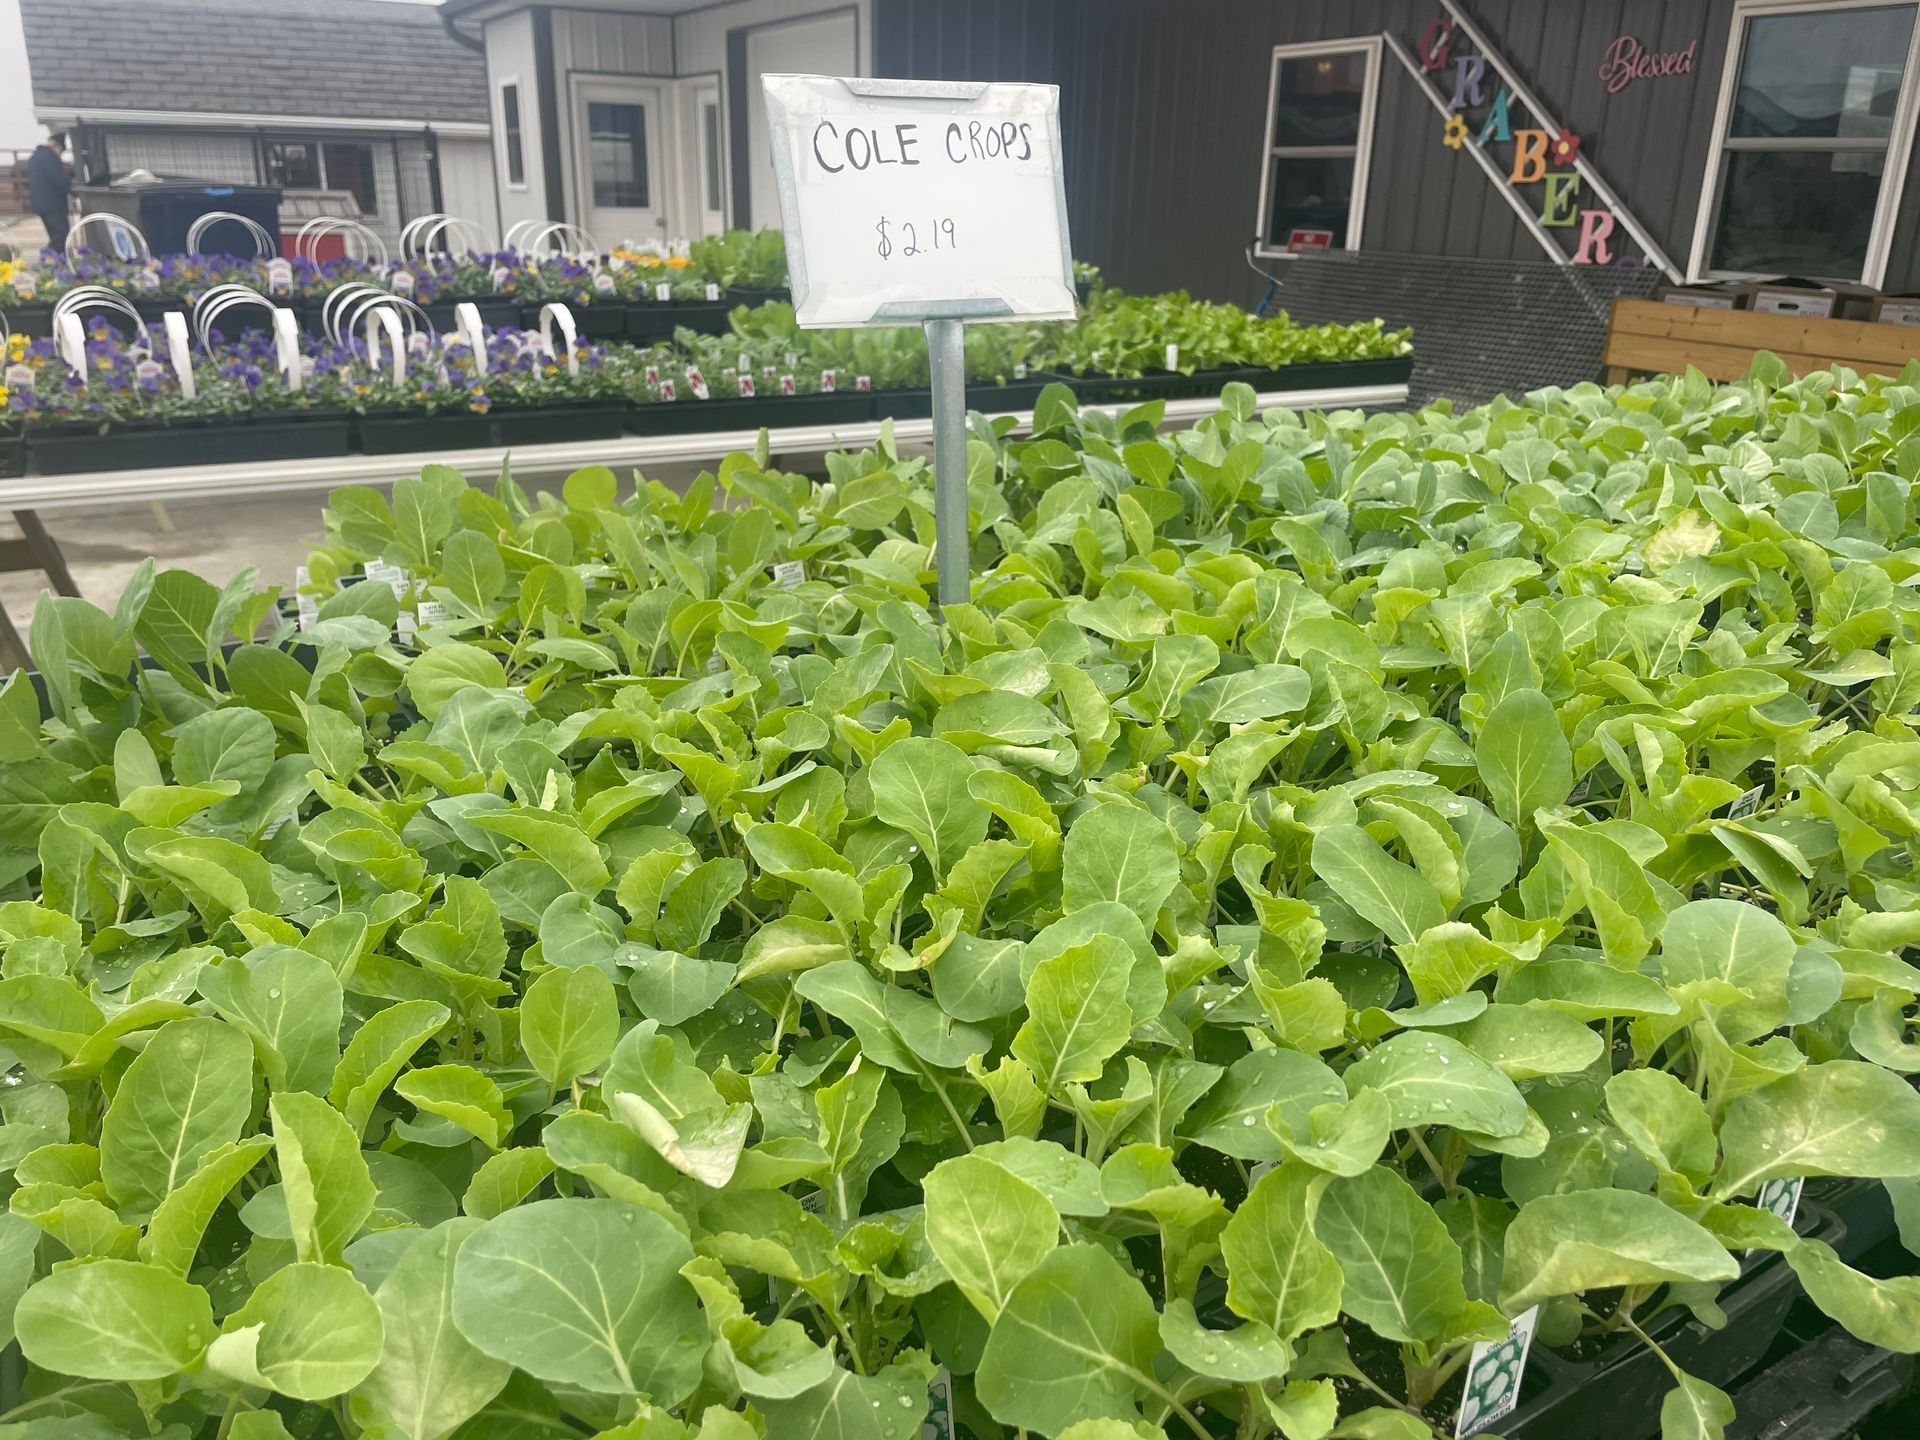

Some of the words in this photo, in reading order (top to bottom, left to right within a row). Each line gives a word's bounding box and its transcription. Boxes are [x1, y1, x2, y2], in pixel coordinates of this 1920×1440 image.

[1599, 36, 1697, 93] Blessed
[813, 118, 921, 174] COLE
[945, 120, 1032, 164] CROPS
[875, 215, 957, 261] $2.19
